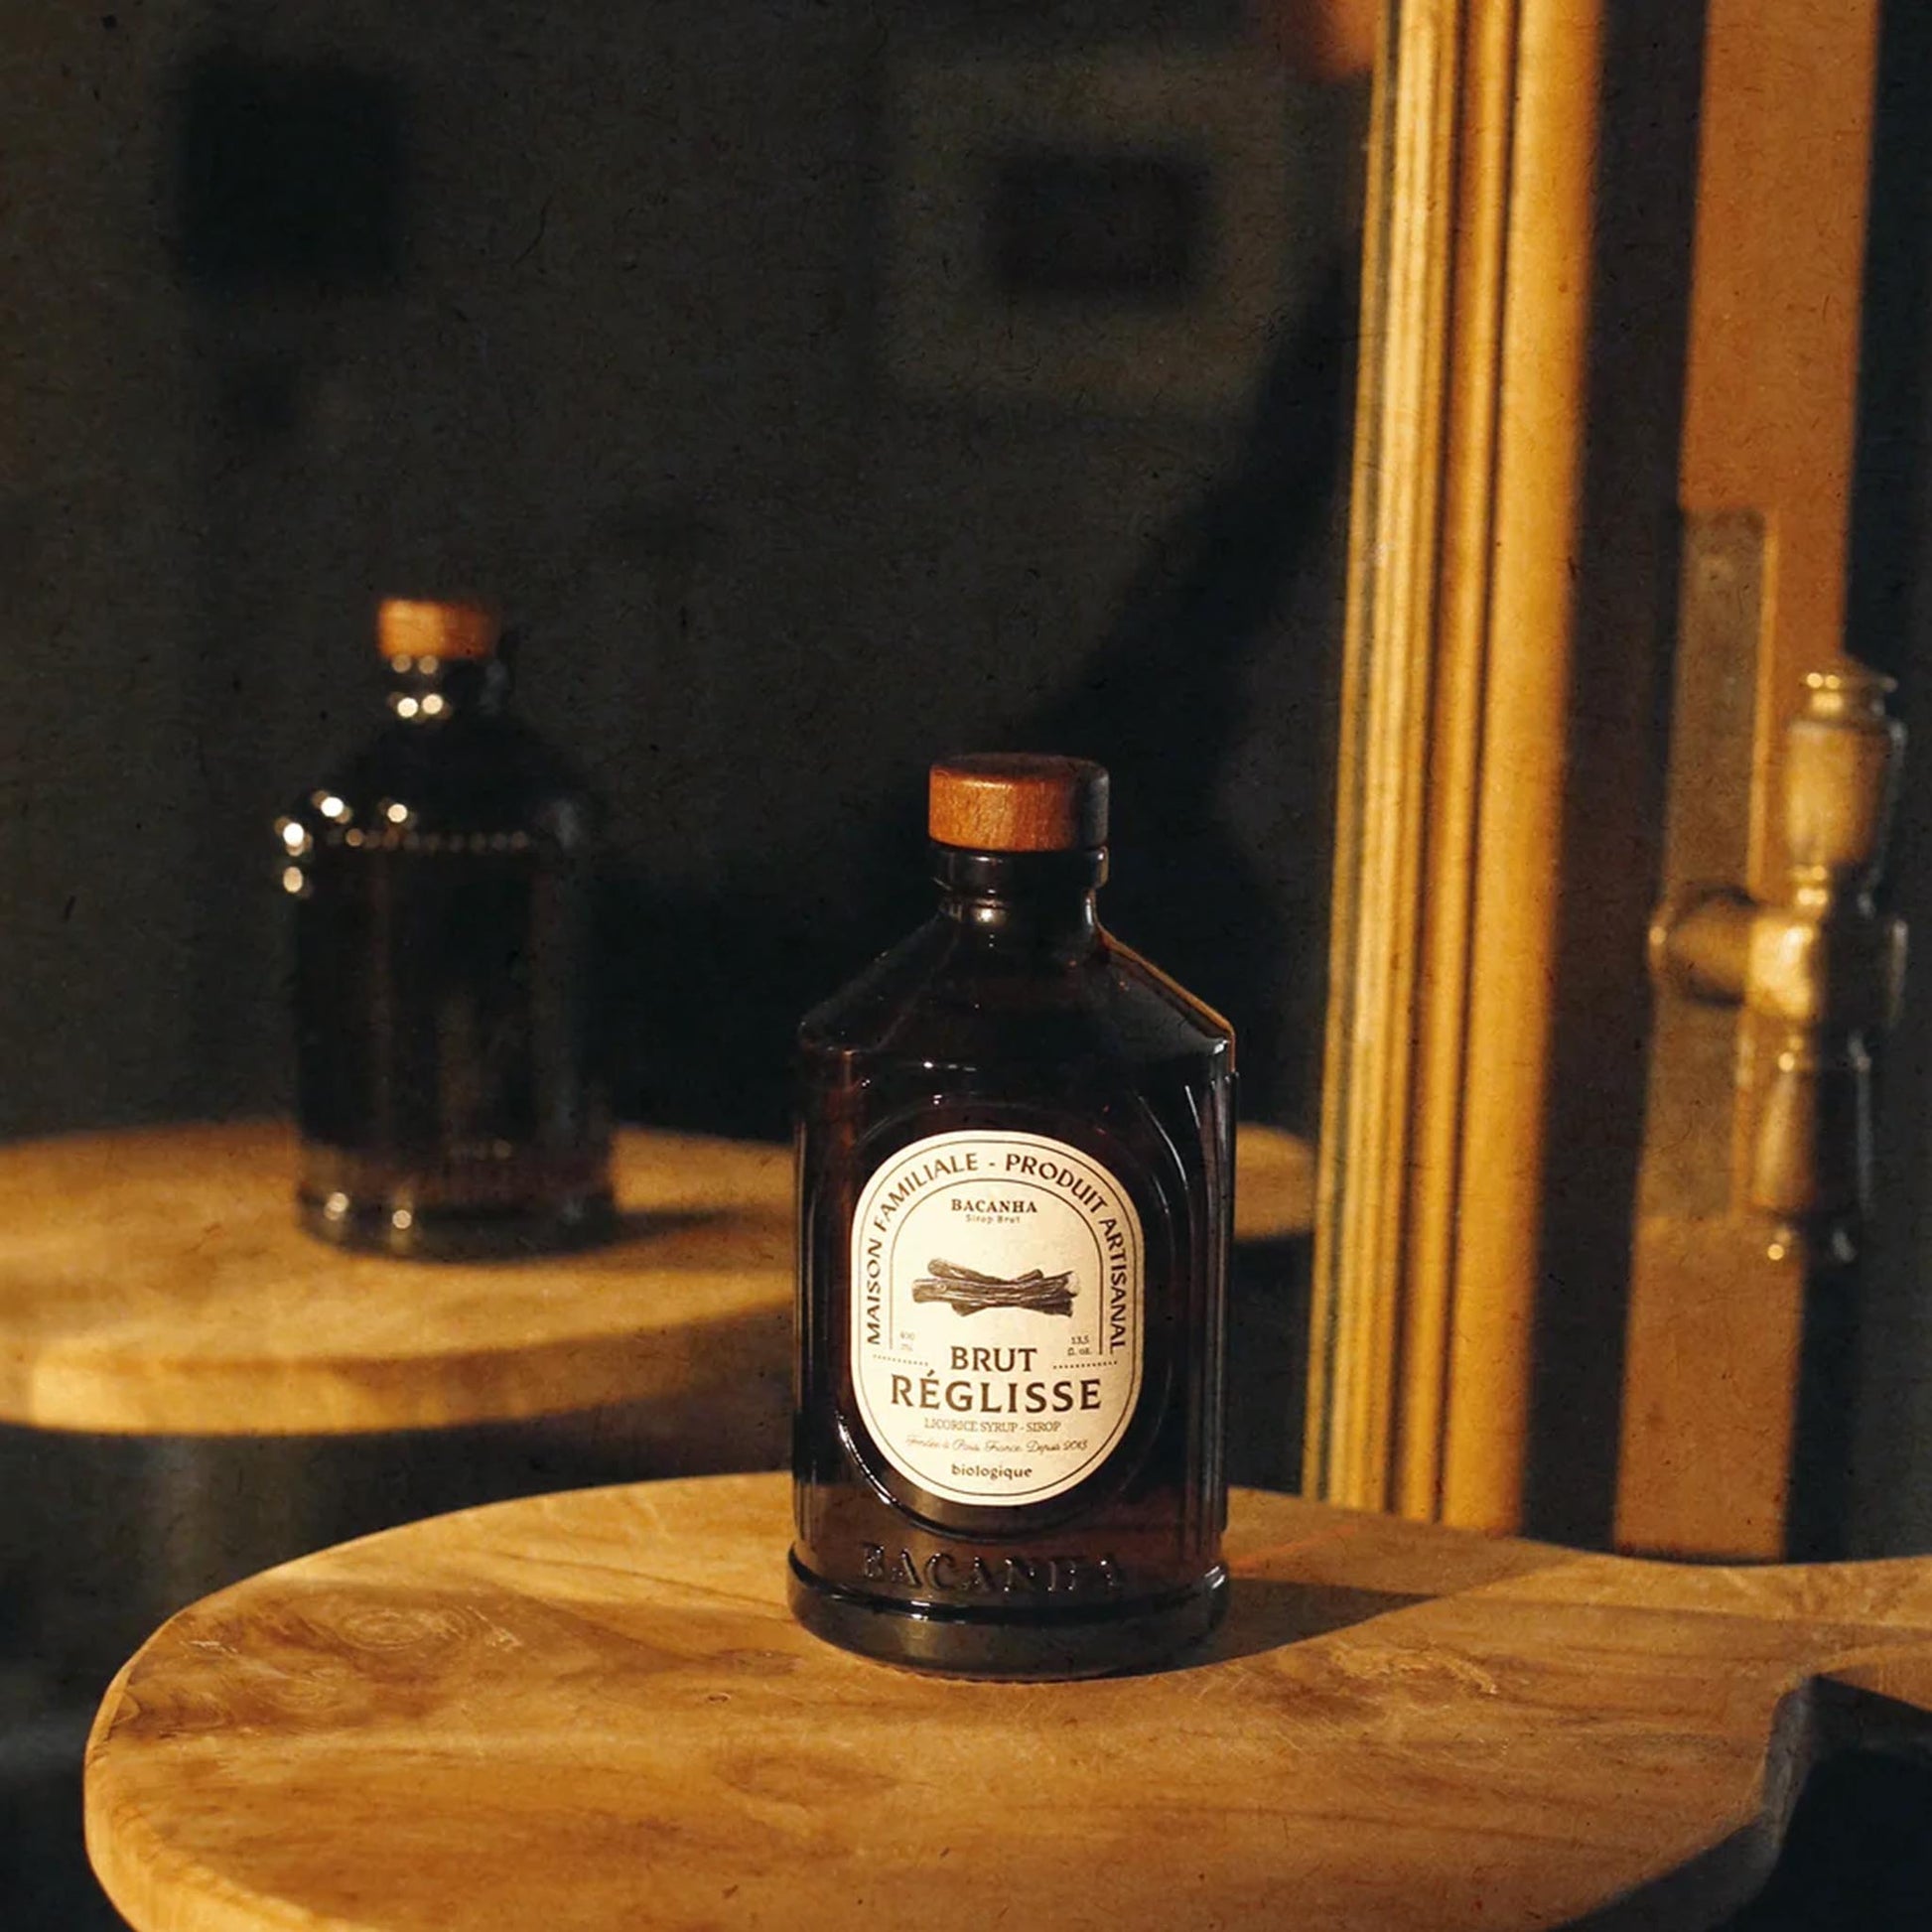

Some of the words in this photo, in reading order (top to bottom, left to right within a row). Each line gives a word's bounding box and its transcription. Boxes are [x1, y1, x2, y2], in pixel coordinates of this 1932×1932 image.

[874, 1153, 978, 1233] FAMILIALE
[951, 1198, 1038, 1213] BACANHA
[1005, 1153, 1109, 1214] PRODUIT
[867, 1238, 882, 1345] MAISON
[1098, 1218, 1127, 1354] ARTISANAL
[950, 1346, 1038, 1373] BRUT
[891, 1369, 1102, 1414] RÉGLISSE
[923, 1418, 979, 1432] LICORICE
[980, 1421, 1019, 1433] SYRUP
[1026, 1421, 1062, 1433] SIROP
[950, 1463, 1034, 1480] biologique
